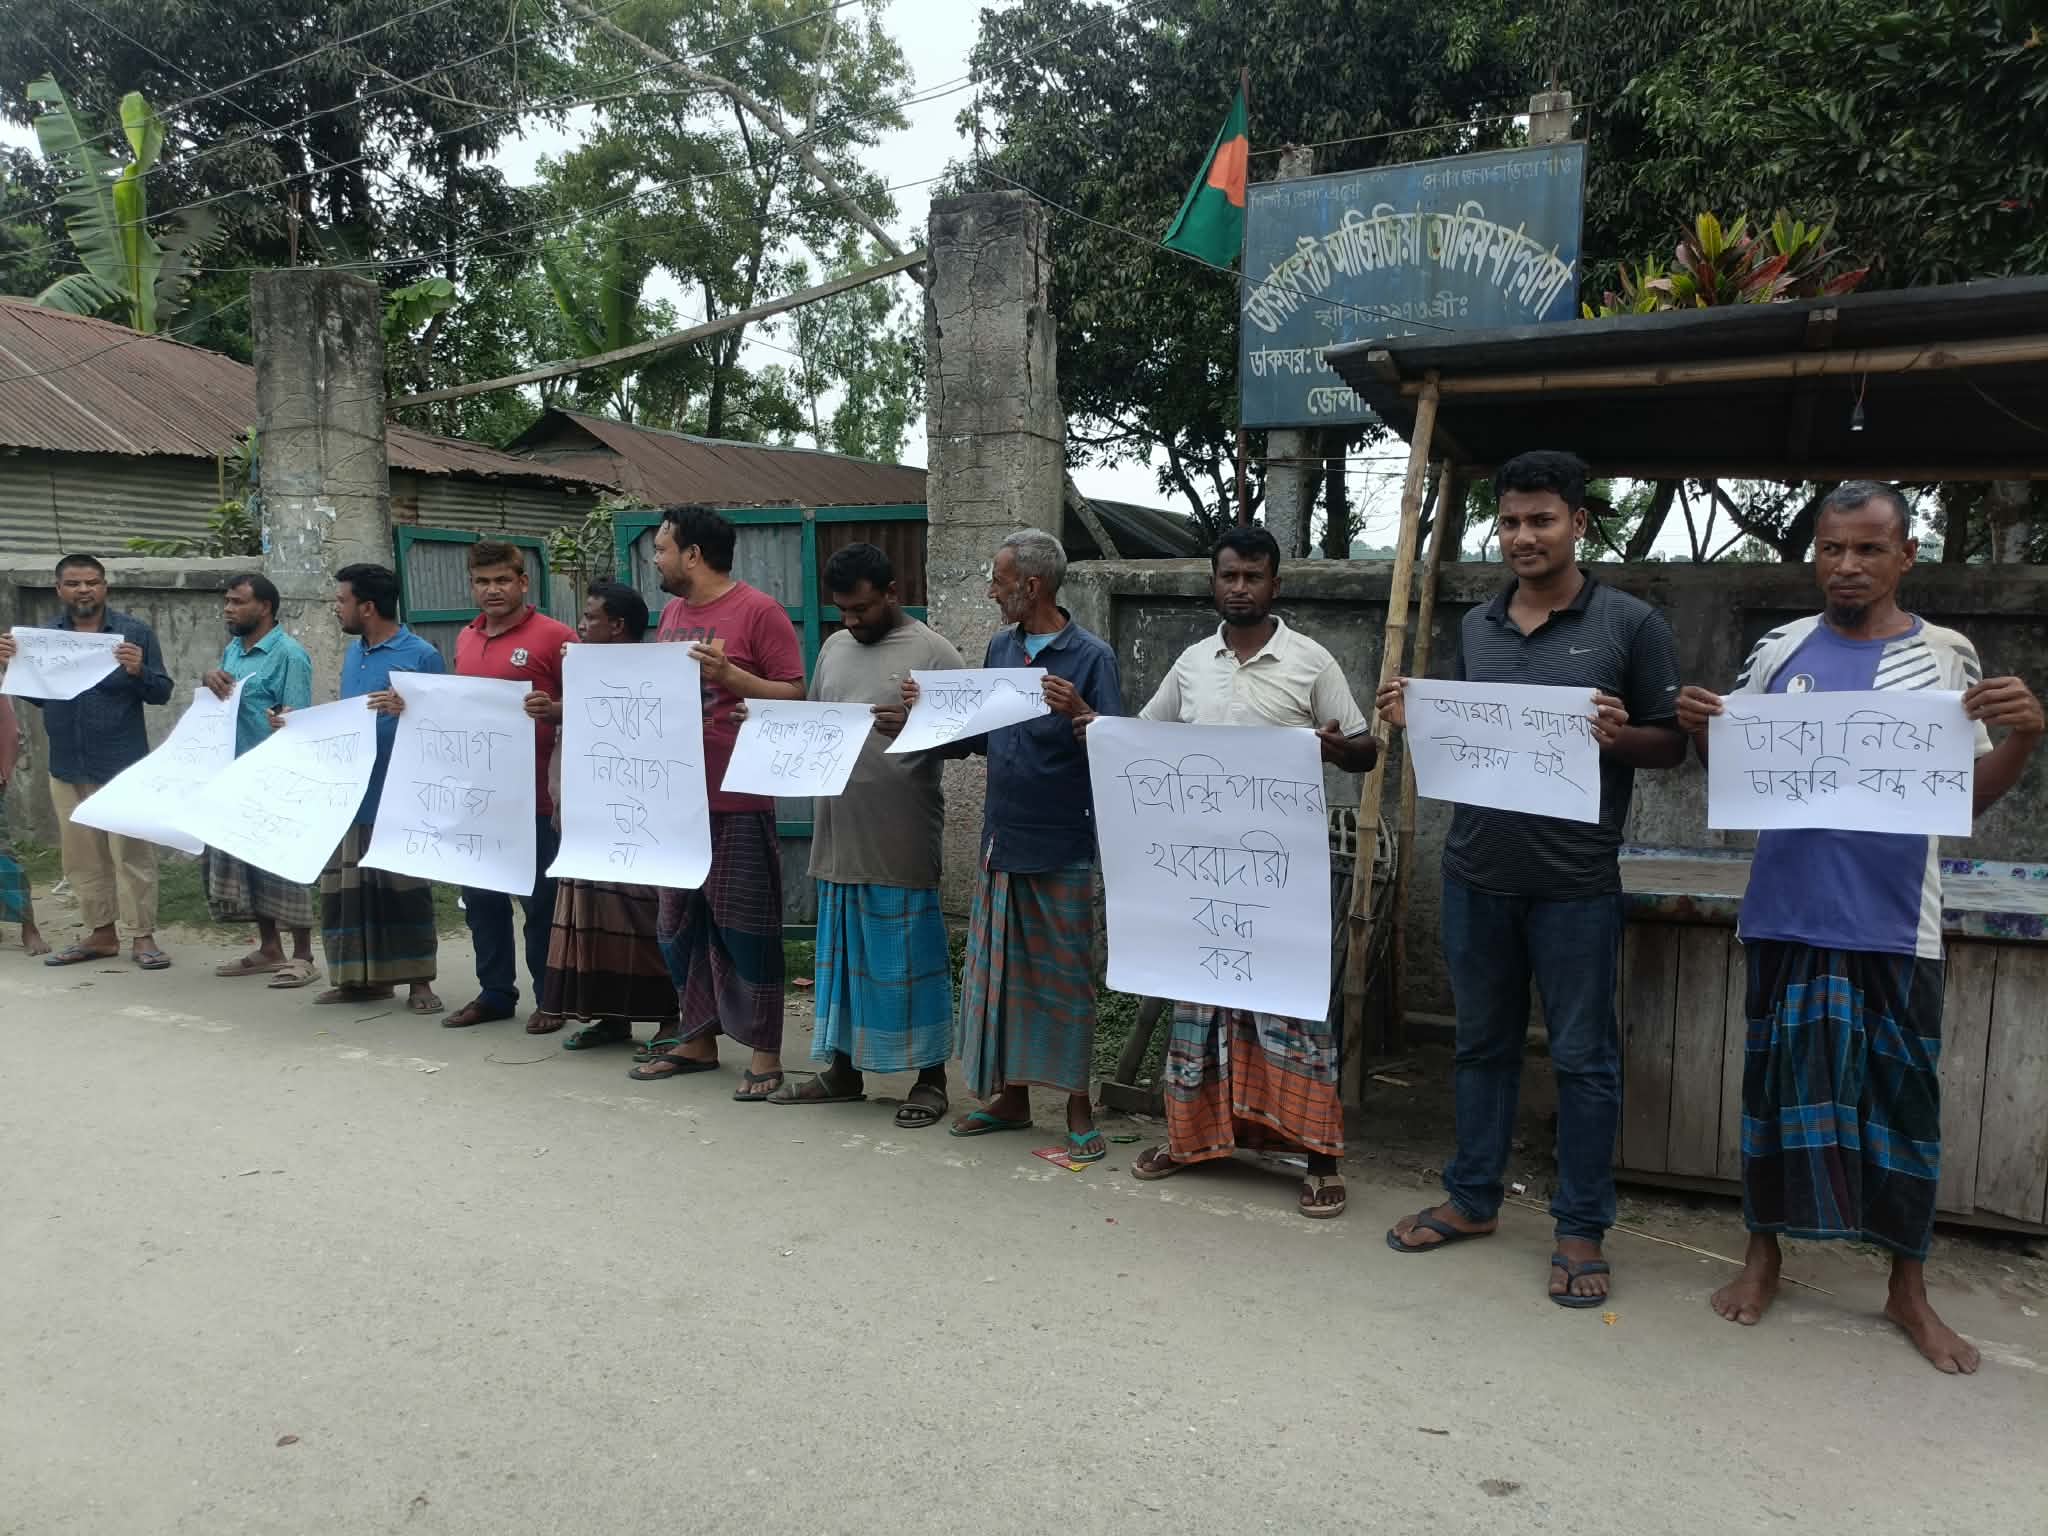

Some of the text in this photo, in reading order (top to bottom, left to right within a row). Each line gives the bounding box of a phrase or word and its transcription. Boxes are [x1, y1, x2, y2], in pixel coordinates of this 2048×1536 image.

[1418, 697, 1513, 730] আমরা
[1724, 710, 1944, 755] টাকা নিয়ে
[415, 718, 513, 772] নিয়োগ
[1527, 740, 1588, 794] চাই
[584, 742, 695, 801] নিয়োগ
[1743, 755, 1968, 806] চাকুরি বন্ধ কর
[400, 819, 443, 858] চাই
[605, 795, 661, 846] চাই
[608, 842, 646, 869] না
[1189, 896, 1271, 938] বন্ধ
[1199, 946, 1253, 981] কর
